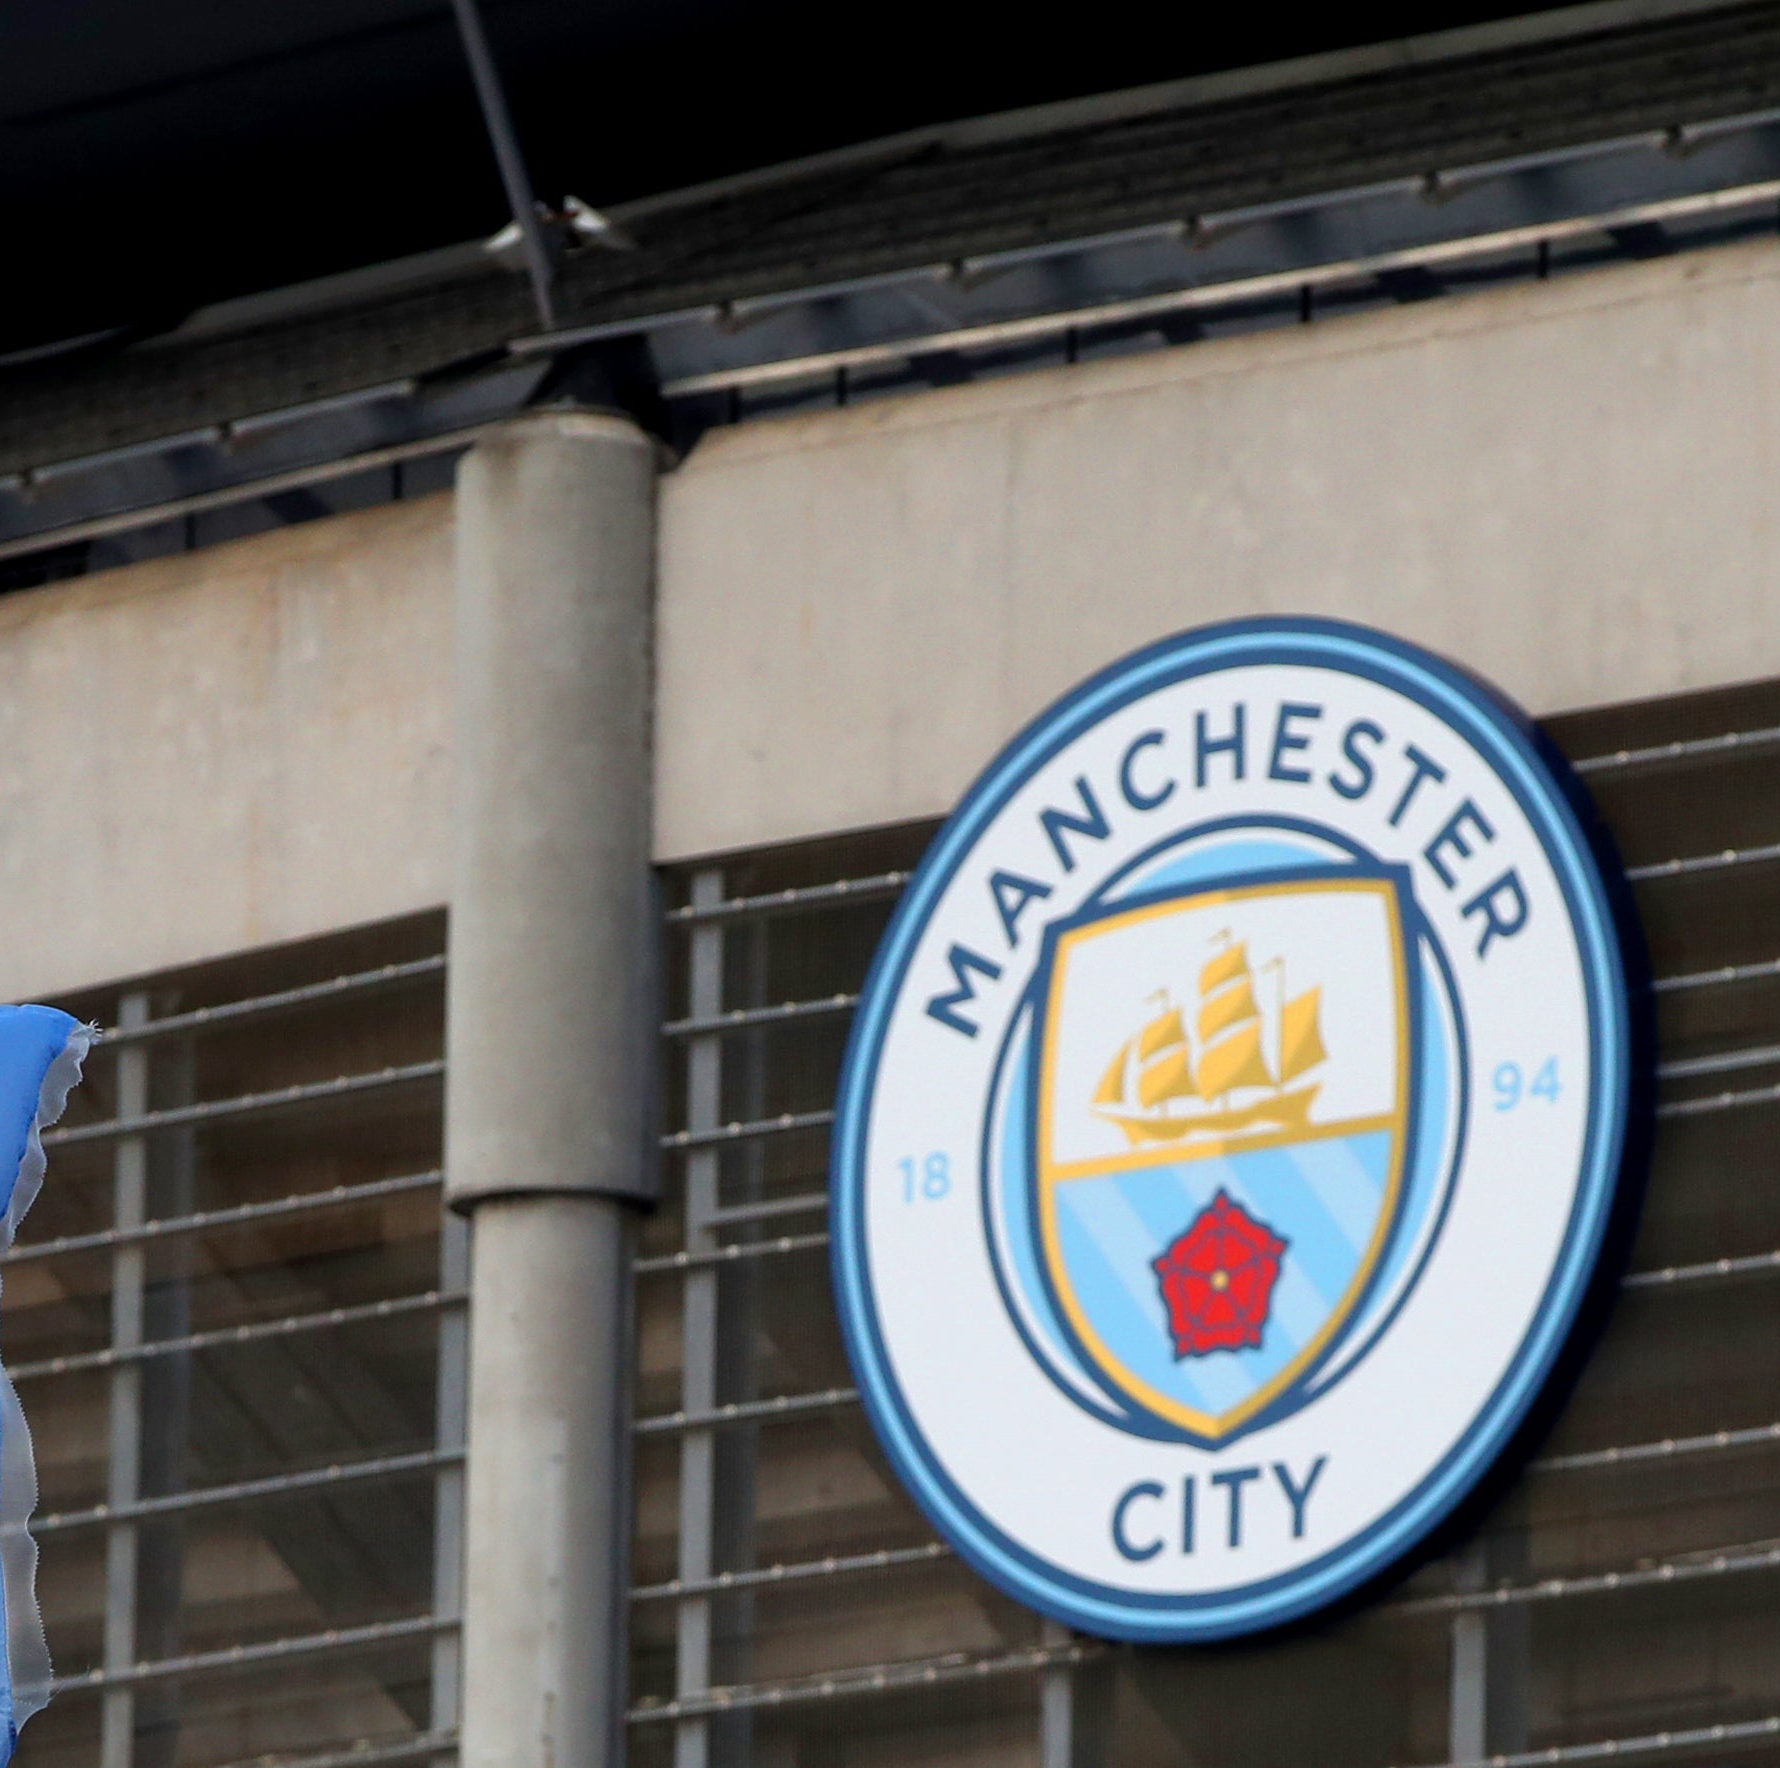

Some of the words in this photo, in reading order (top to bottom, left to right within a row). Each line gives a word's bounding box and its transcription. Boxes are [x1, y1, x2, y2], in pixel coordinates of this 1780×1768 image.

[925, 703, 1529, 1039] MANCHESTER
[1491, 1057, 1562, 1112] 94
[898, 1151, 953, 1204] 18
[1112, 1456, 1328, 1563] CITY
